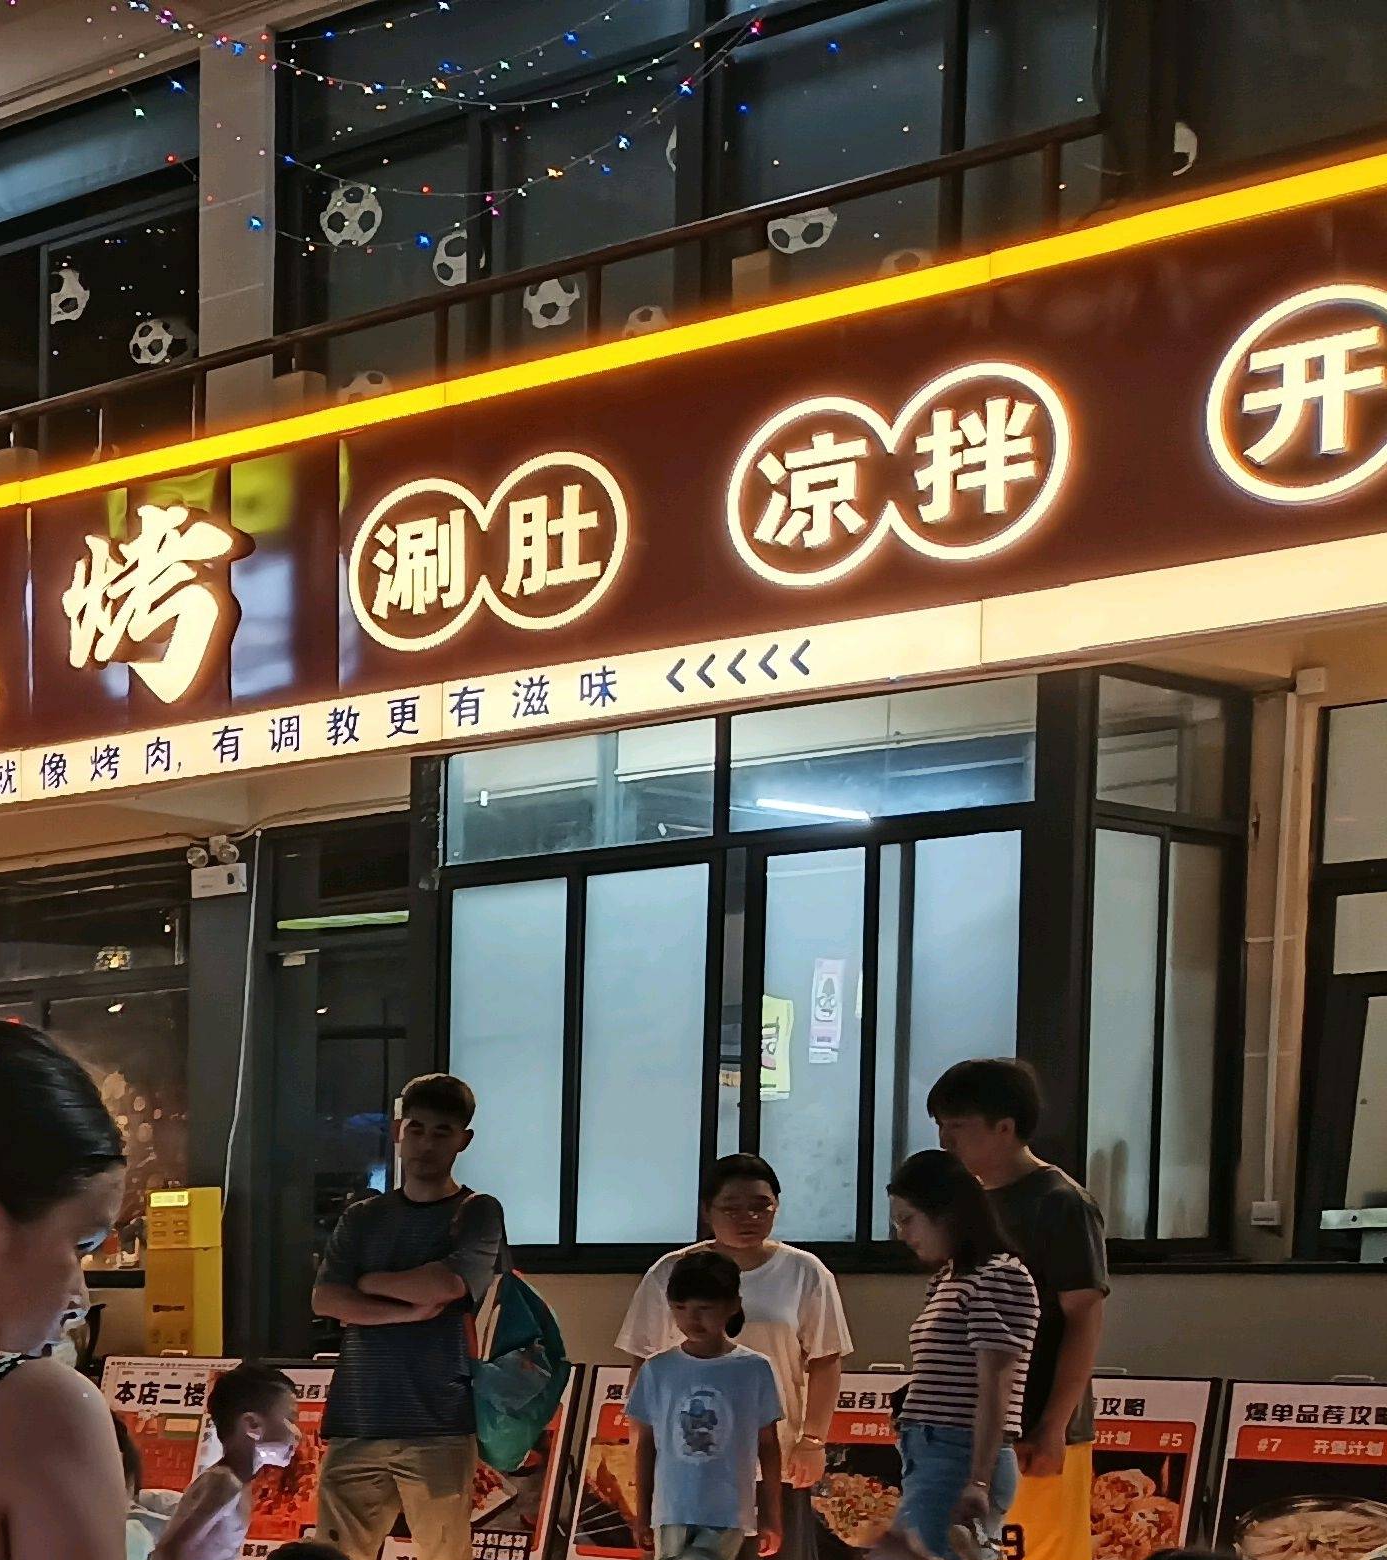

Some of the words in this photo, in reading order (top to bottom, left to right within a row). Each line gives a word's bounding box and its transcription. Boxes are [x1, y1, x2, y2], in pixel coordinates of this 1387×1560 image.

[1242, 326, 1385, 465] 开
[755, 396, 1039, 550] 凉拌
[371, 482, 603, 618] 涮肚
[114, 1380, 207, 1408] 本店二楼
